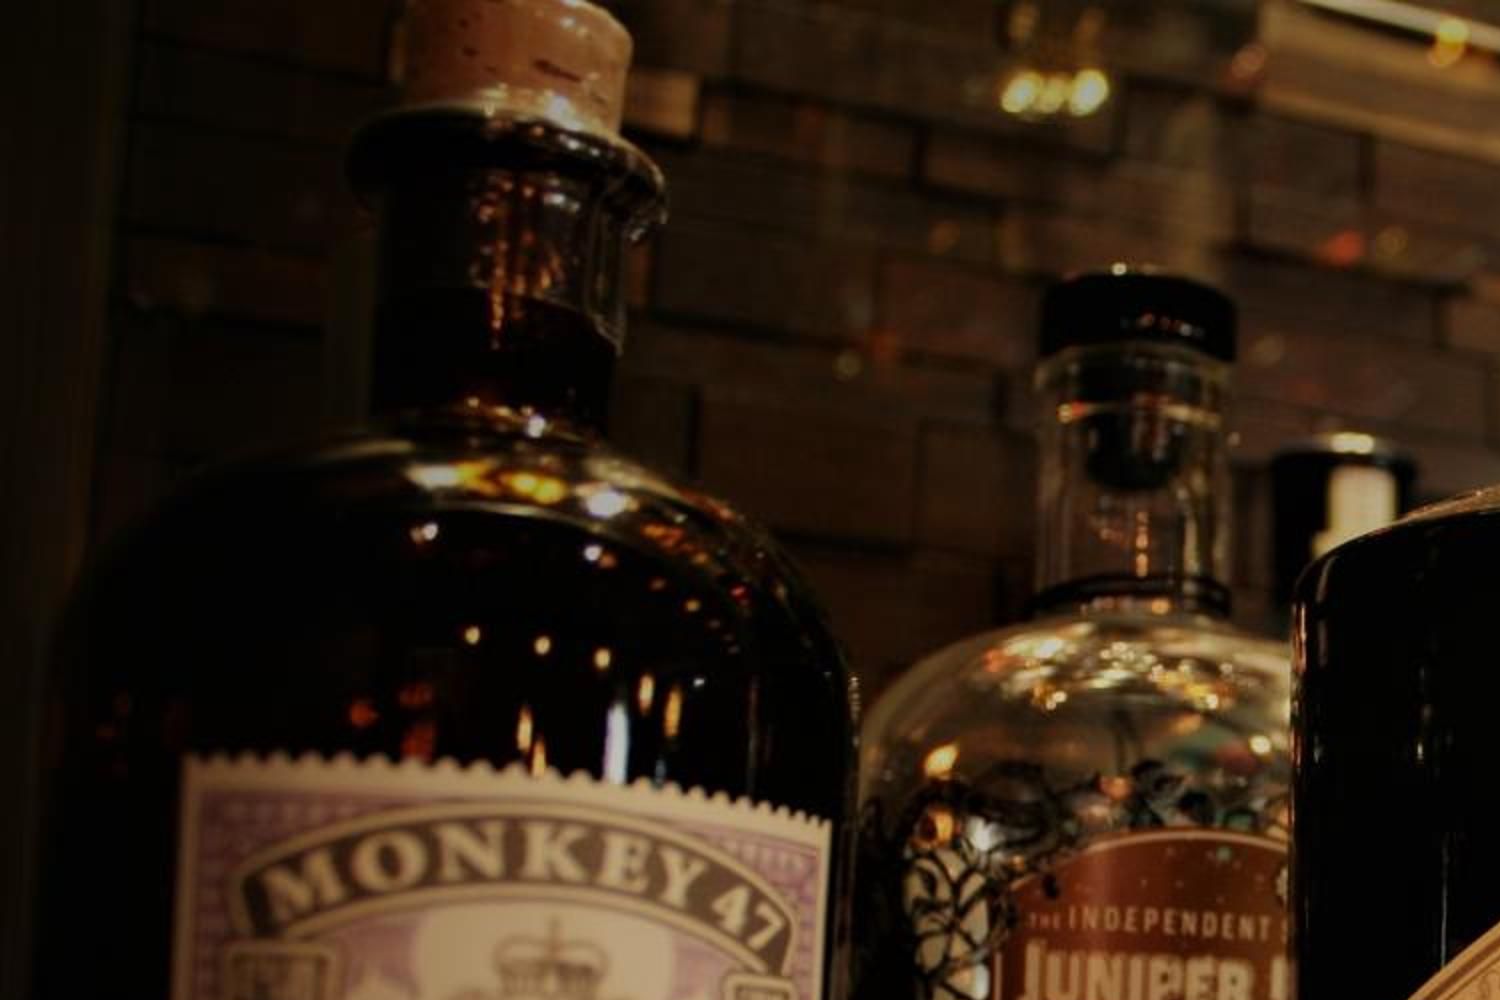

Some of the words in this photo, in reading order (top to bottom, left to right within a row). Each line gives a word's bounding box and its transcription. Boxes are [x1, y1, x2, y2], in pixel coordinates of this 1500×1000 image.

[260, 818, 706, 917] MONKEY
[711, 869, 787, 948] 47
[1068, 905, 1273, 942] INDEPENDENT
